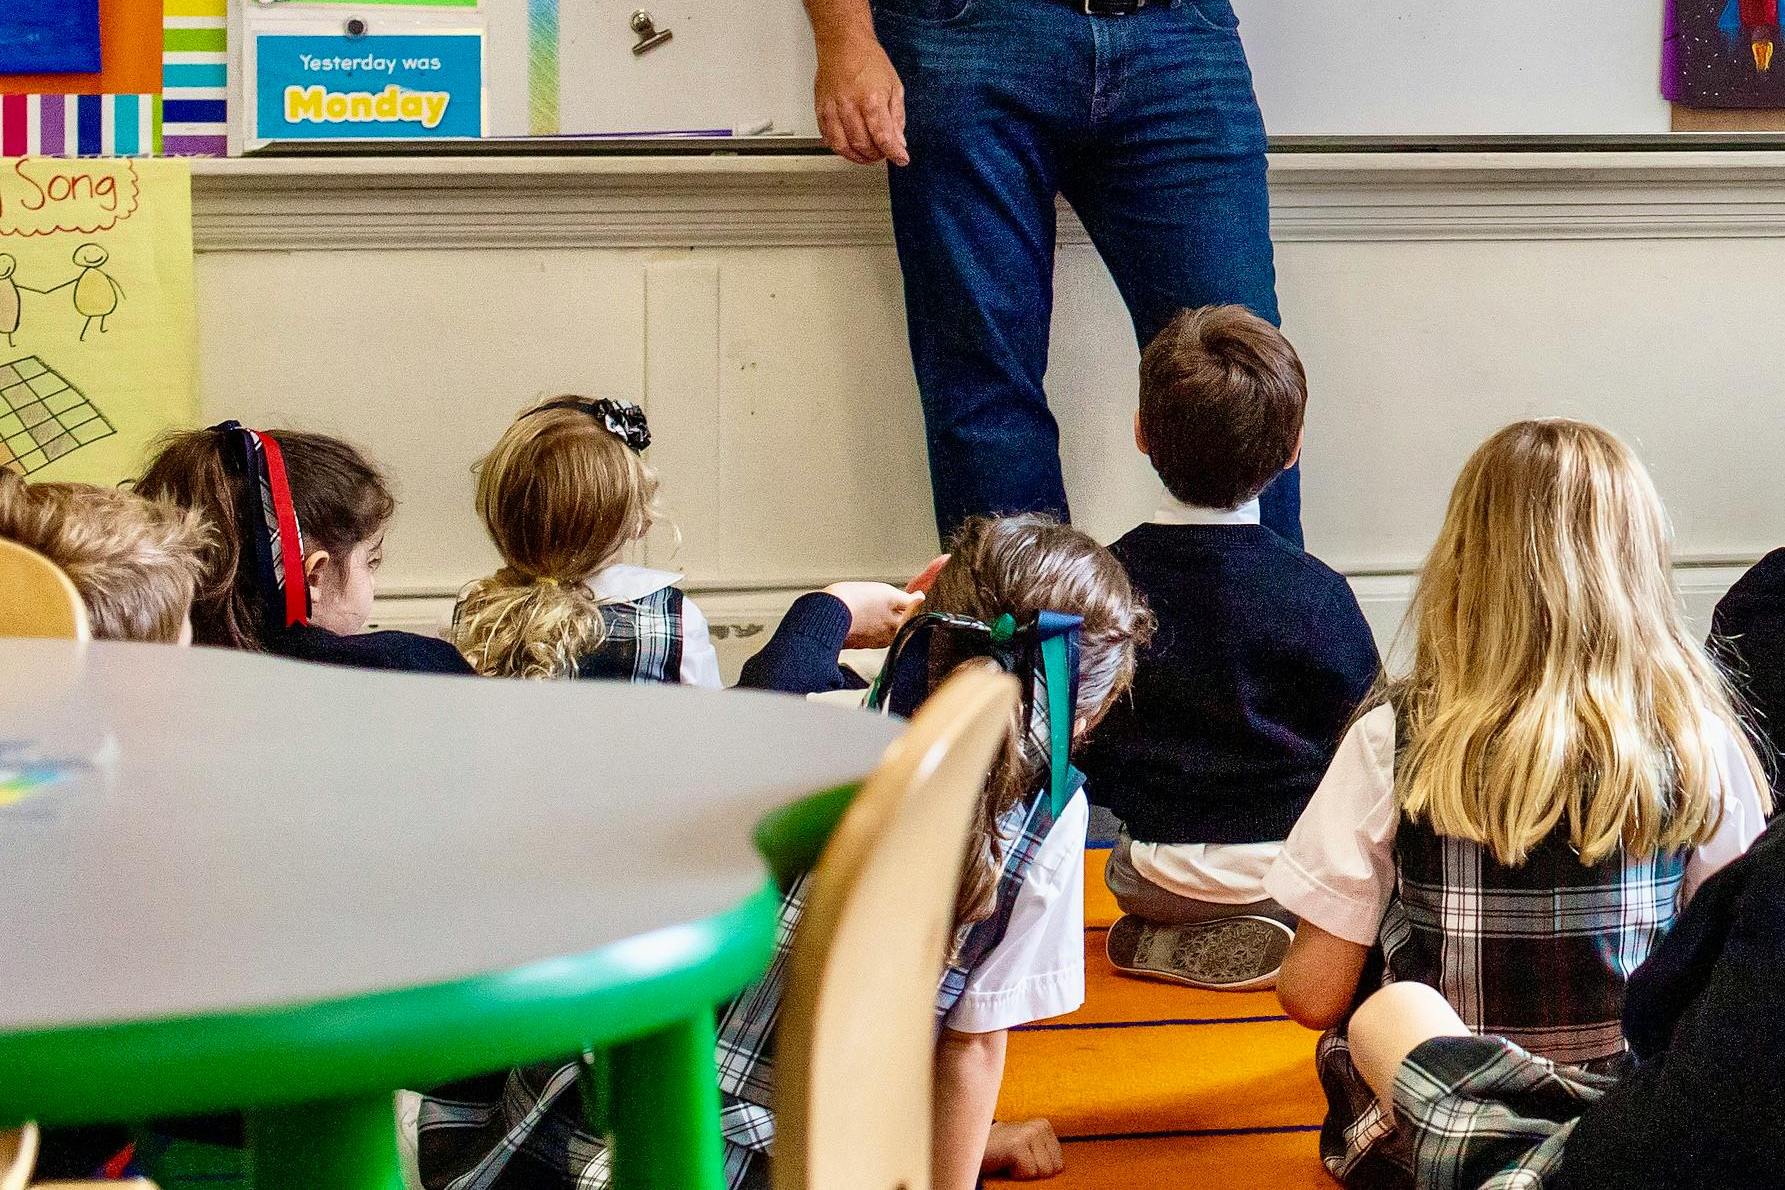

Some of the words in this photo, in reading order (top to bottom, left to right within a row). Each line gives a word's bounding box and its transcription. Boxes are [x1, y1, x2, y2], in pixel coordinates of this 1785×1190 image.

[299, 53, 397, 74] Yesterday
[402, 55, 441, 70] was
[287, 86, 447, 127] Monday
[15, 157, 118, 212] Song
